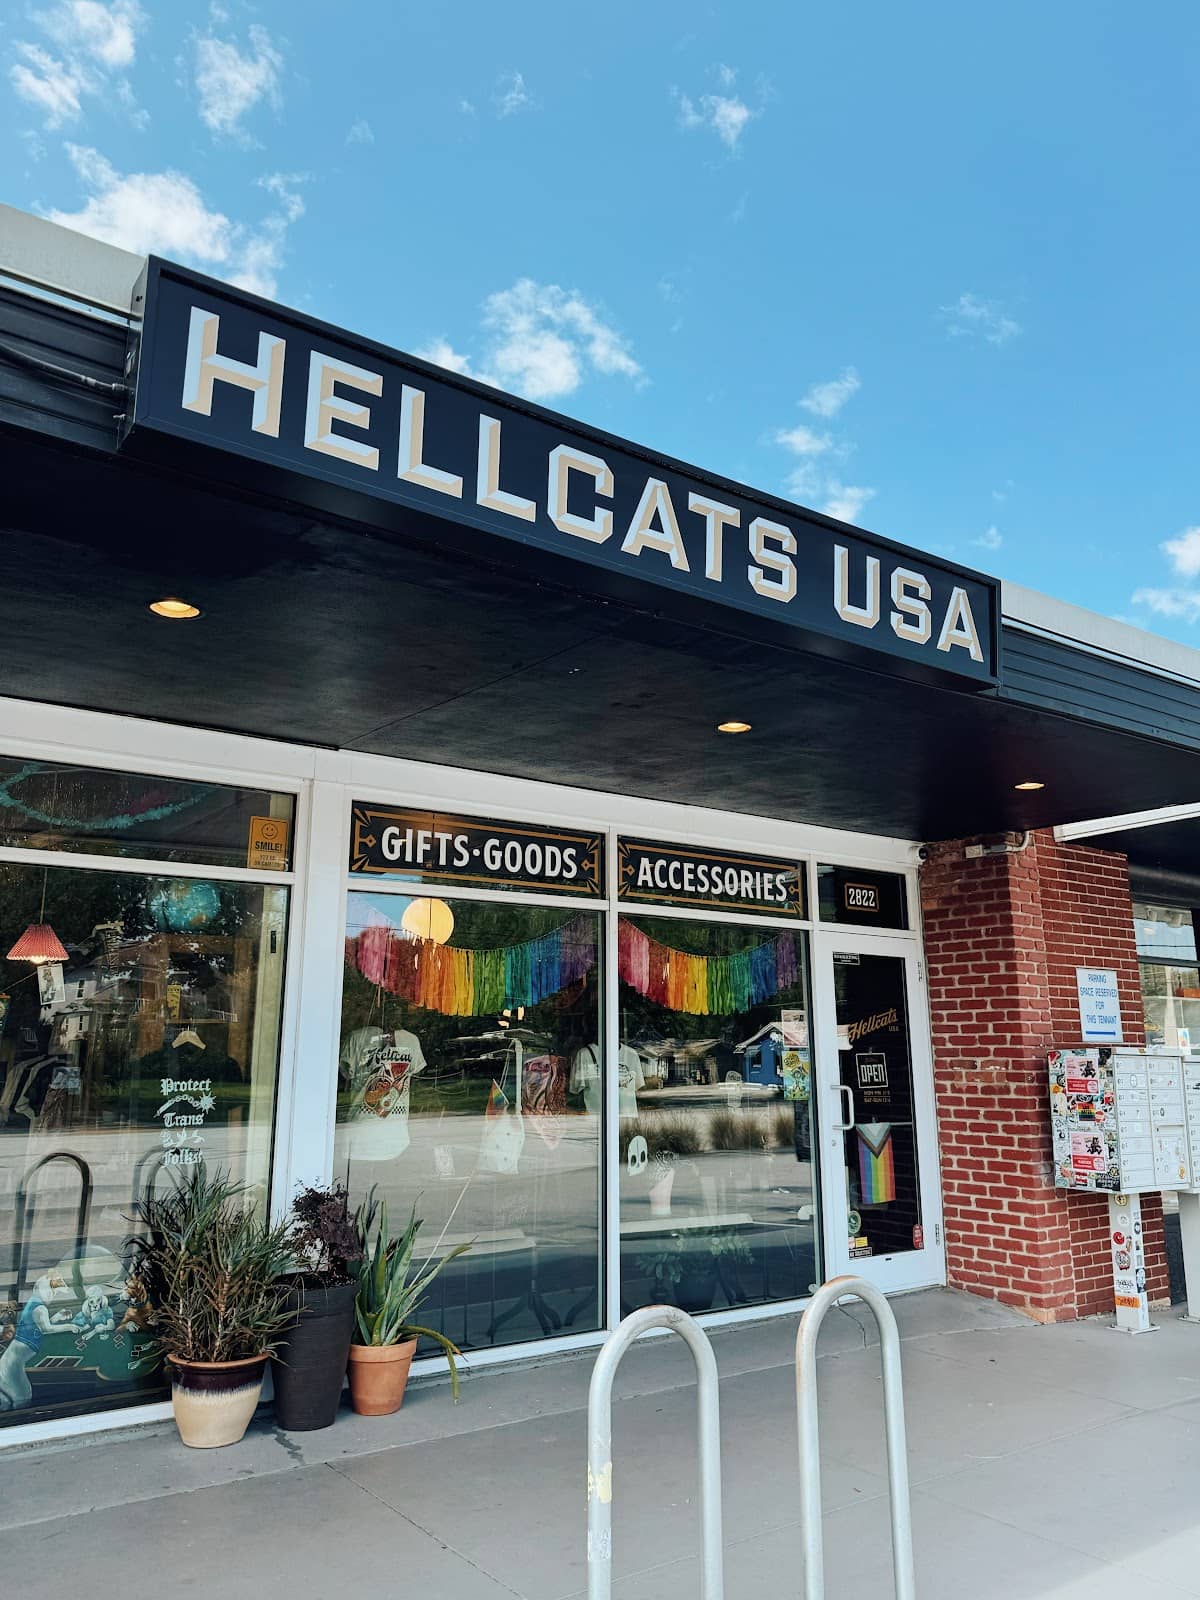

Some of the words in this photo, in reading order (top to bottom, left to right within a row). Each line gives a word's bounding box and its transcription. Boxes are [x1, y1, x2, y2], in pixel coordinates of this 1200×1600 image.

[182, 306, 798, 603] HELLCATS
[834, 544, 984, 663] USA
[636, 857, 787, 902] ACCESSORIES
[848, 887, 876, 908] 2822
[1088, 974, 1106, 983] PARKING
[1080, 987, 1094, 997] SPACE
[1095, 988, 1117, 998] RESERVED
[1095, 1001, 1104, 1010] FOR
[849, 1008, 897, 1043] Hellcats
[1086, 1015, 1096, 1024] THIS
[860, 1064, 885, 1082] OPEN
[161, 1078, 211, 1096] Protect
[163, 1112, 205, 1128] Trans
